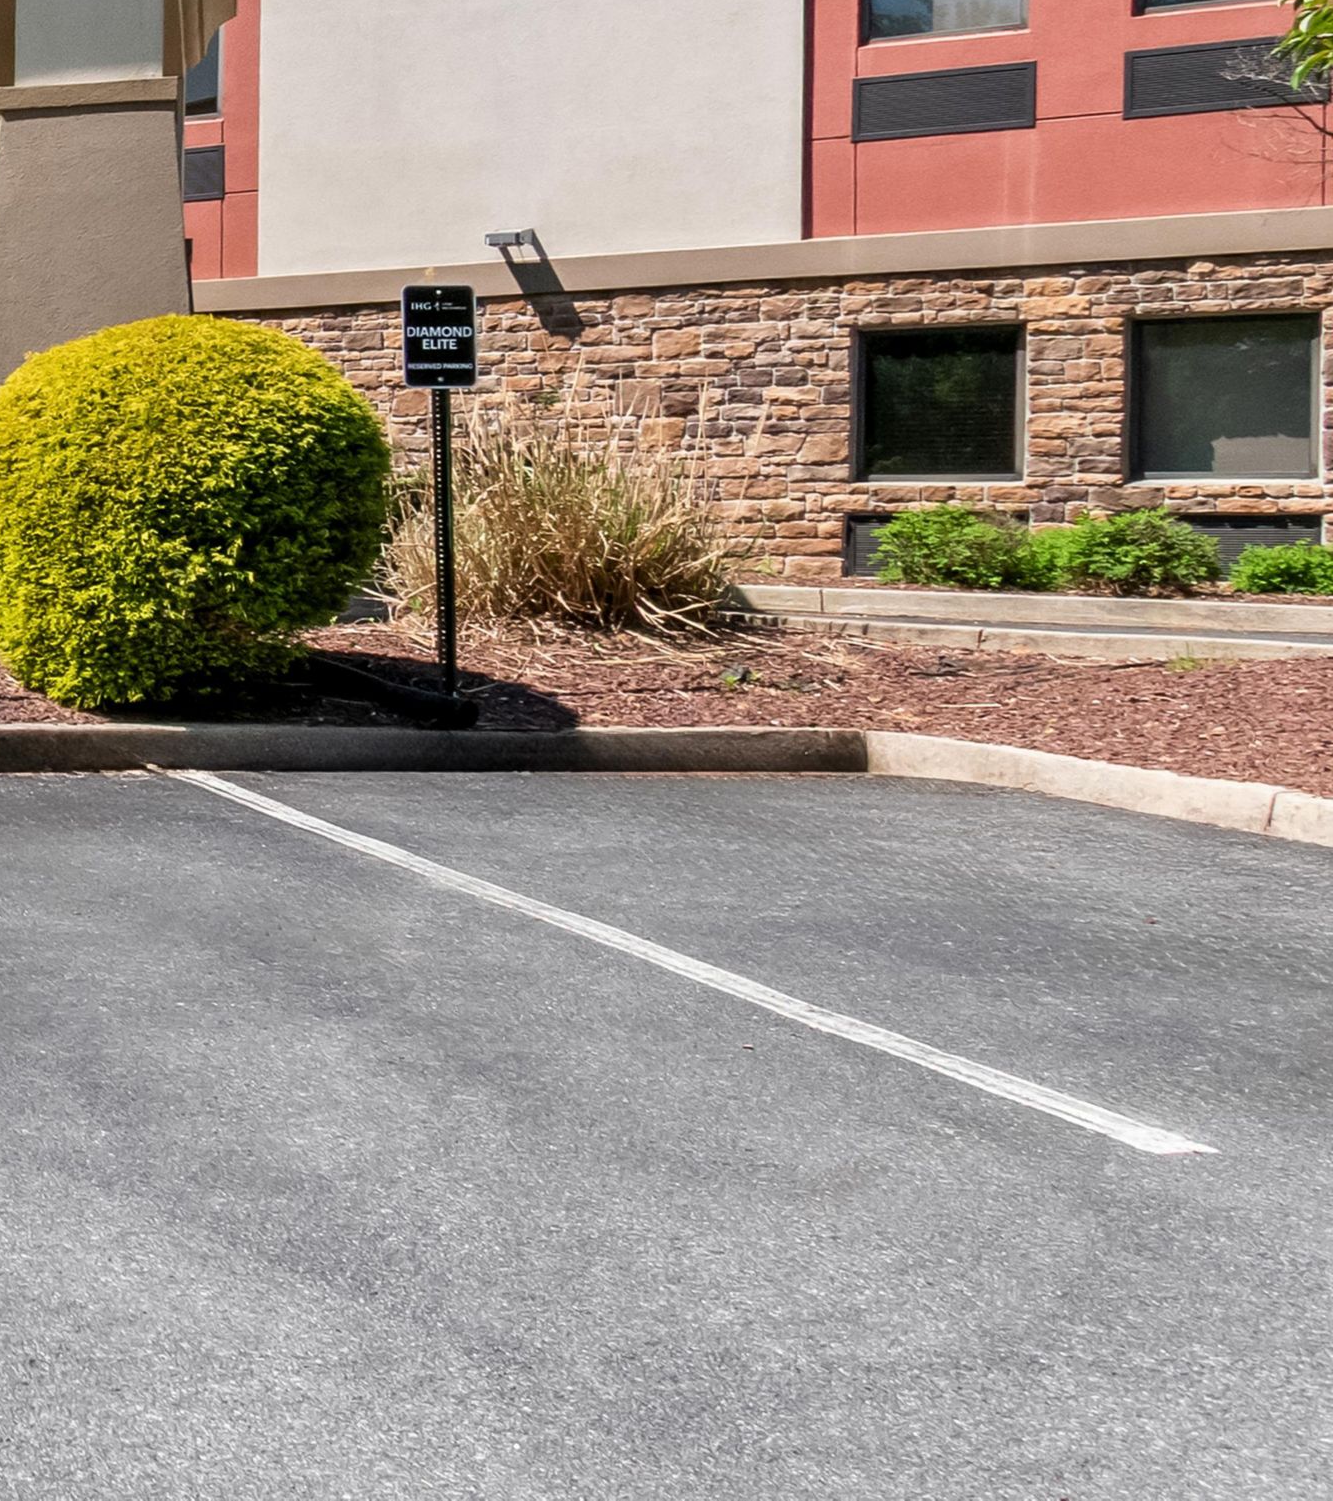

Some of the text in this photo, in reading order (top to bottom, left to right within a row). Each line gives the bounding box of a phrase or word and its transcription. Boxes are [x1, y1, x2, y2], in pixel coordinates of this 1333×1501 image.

[411, 302, 432, 310] IHG
[406, 326, 472, 337] DIAMOND
[422, 338, 458, 350] ELITE
